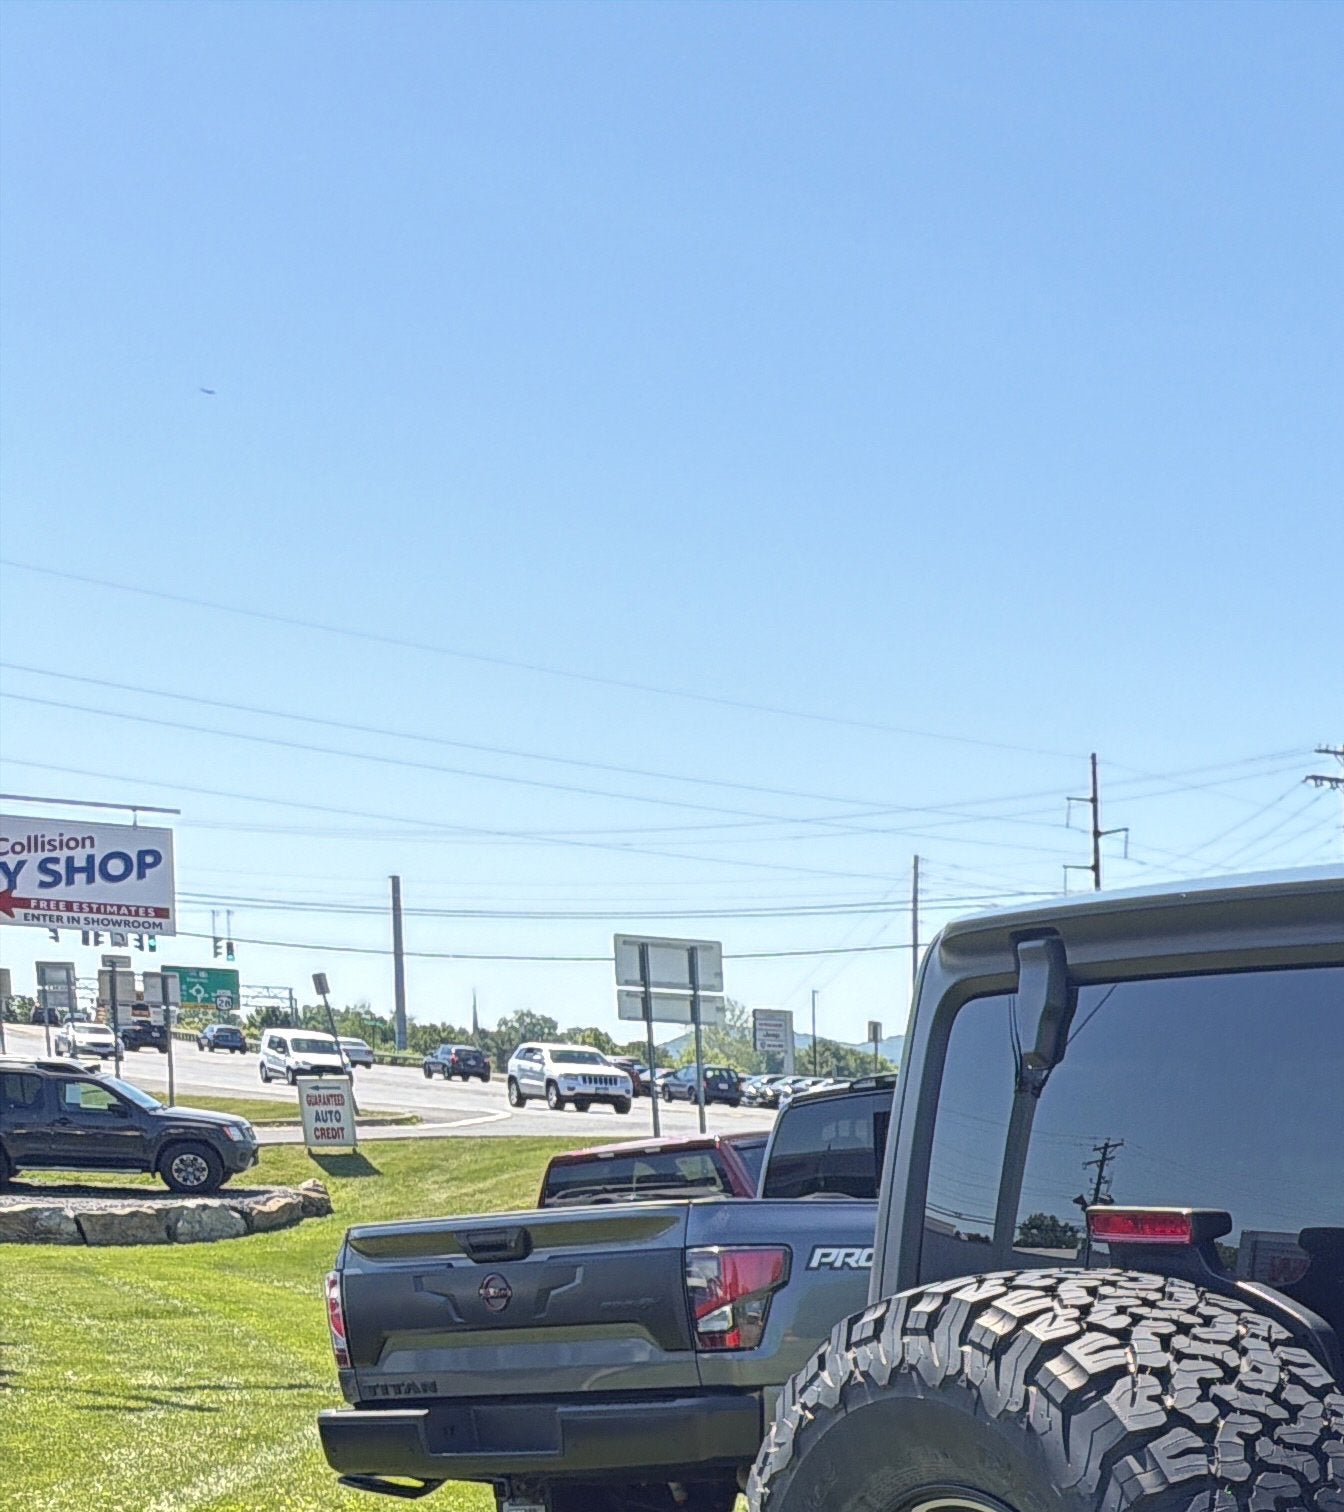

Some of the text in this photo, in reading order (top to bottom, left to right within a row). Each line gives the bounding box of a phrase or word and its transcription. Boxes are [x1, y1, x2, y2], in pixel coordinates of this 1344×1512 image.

[0, 833, 95, 856] Collision
[37, 849, 163, 890] SHOP
[30, 899, 156, 918] FREE ESTIMATES
[23, 912, 163, 931] ENTER IN SHOWROOM
[306, 1093, 345, 1106] GUARANTEED
[314, 1109, 342, 1124] AUTO
[313, 1126, 345, 1140] CREDIT
[362, 1381, 438, 1397] TITAN
